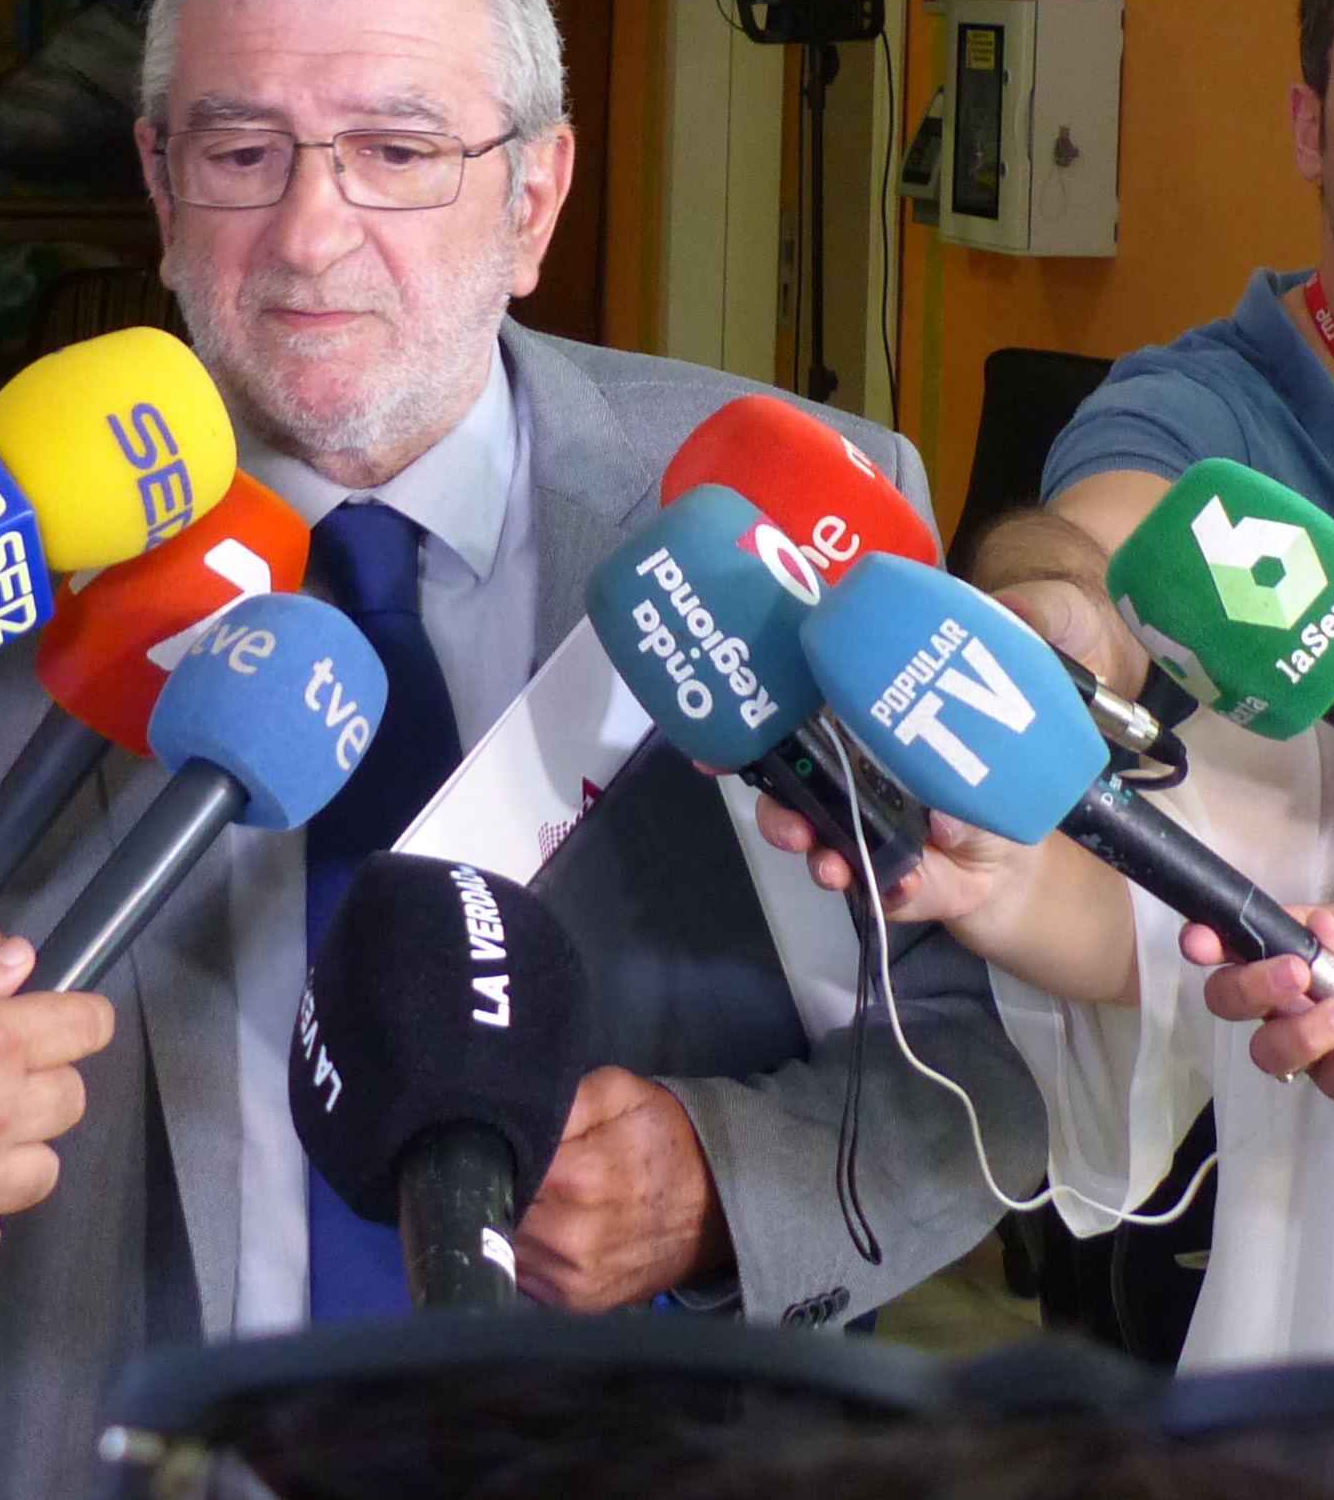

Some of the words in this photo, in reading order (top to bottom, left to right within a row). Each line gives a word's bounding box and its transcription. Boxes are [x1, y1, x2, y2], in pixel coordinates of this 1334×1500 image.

[632, 598, 714, 720] Onda
[635, 546, 780, 730] Regional
[870, 617, 970, 729] POPULAR
[304, 656, 371, 771] tve
[893, 635, 1038, 788] TV
[472, 973, 510, 1028] LA
[313, 1043, 344, 1113] LA
